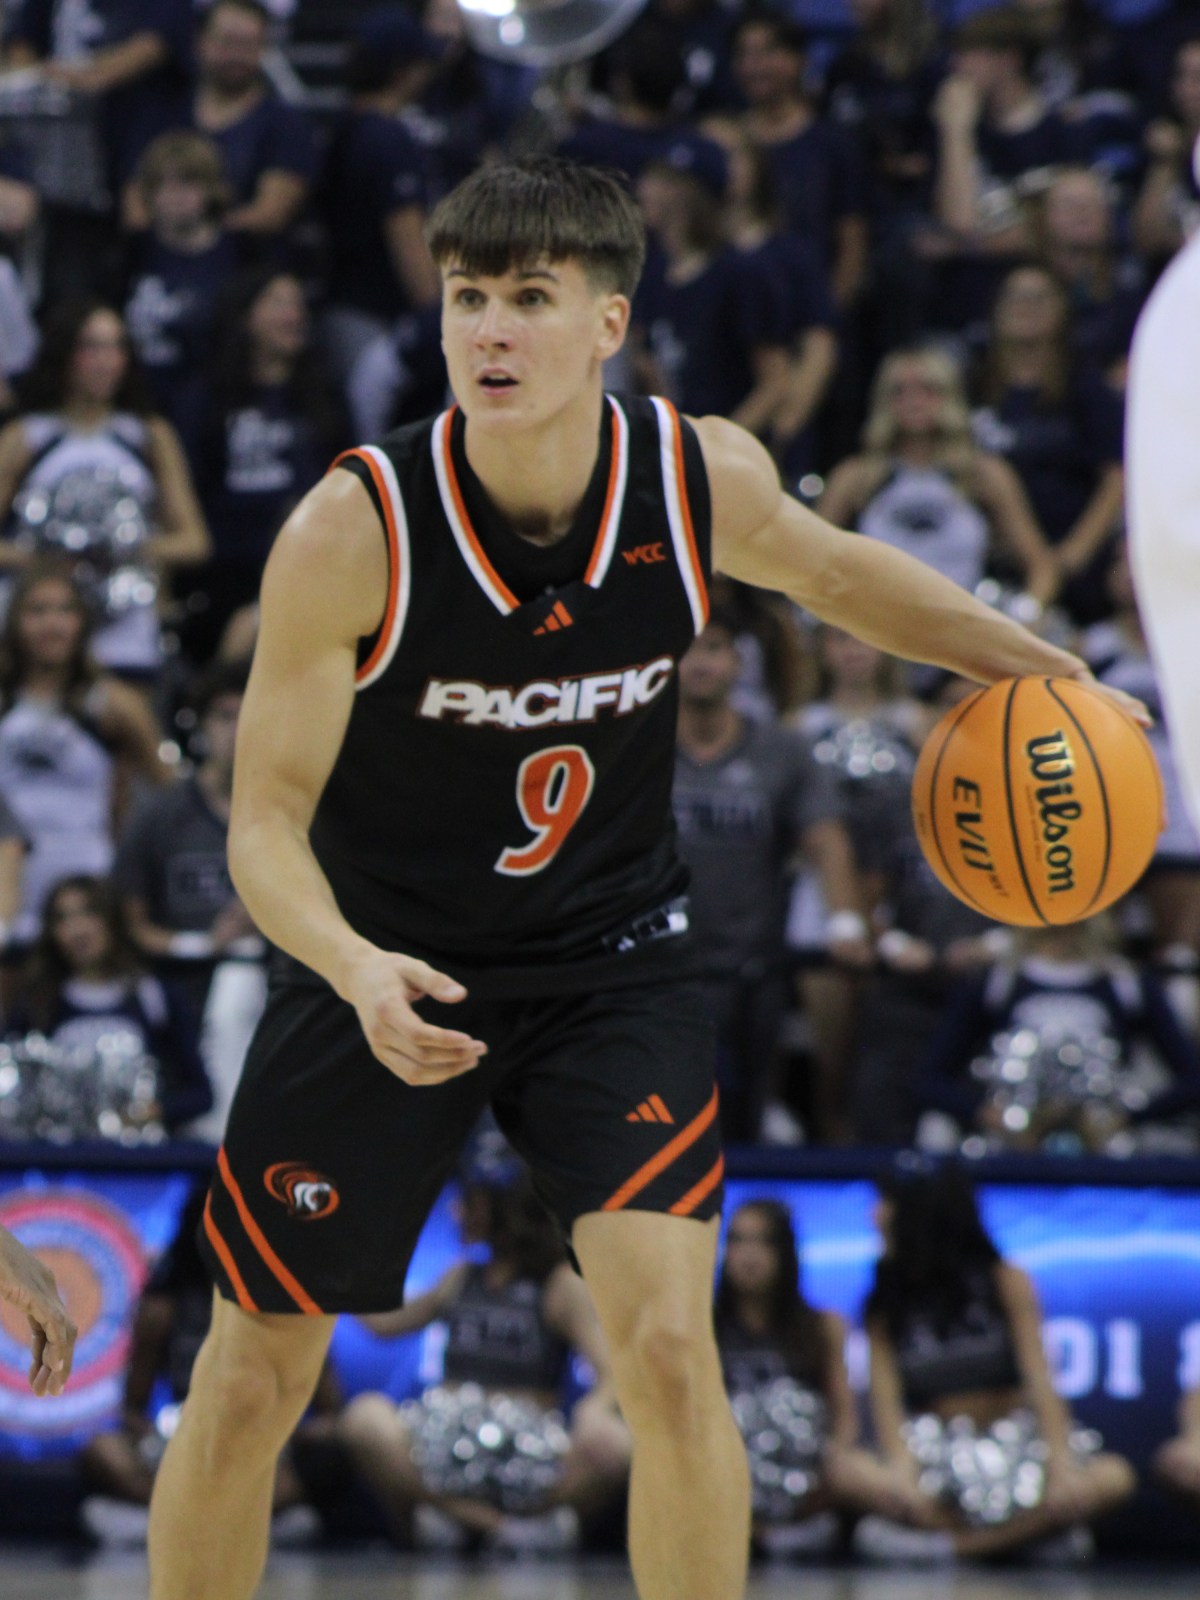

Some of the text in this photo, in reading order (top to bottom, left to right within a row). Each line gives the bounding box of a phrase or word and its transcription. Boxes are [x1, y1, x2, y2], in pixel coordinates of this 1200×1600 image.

[417, 656, 674, 729] PACIFIC
[494, 744, 595, 877] 9
[1025, 729, 1082, 894] Wilson
